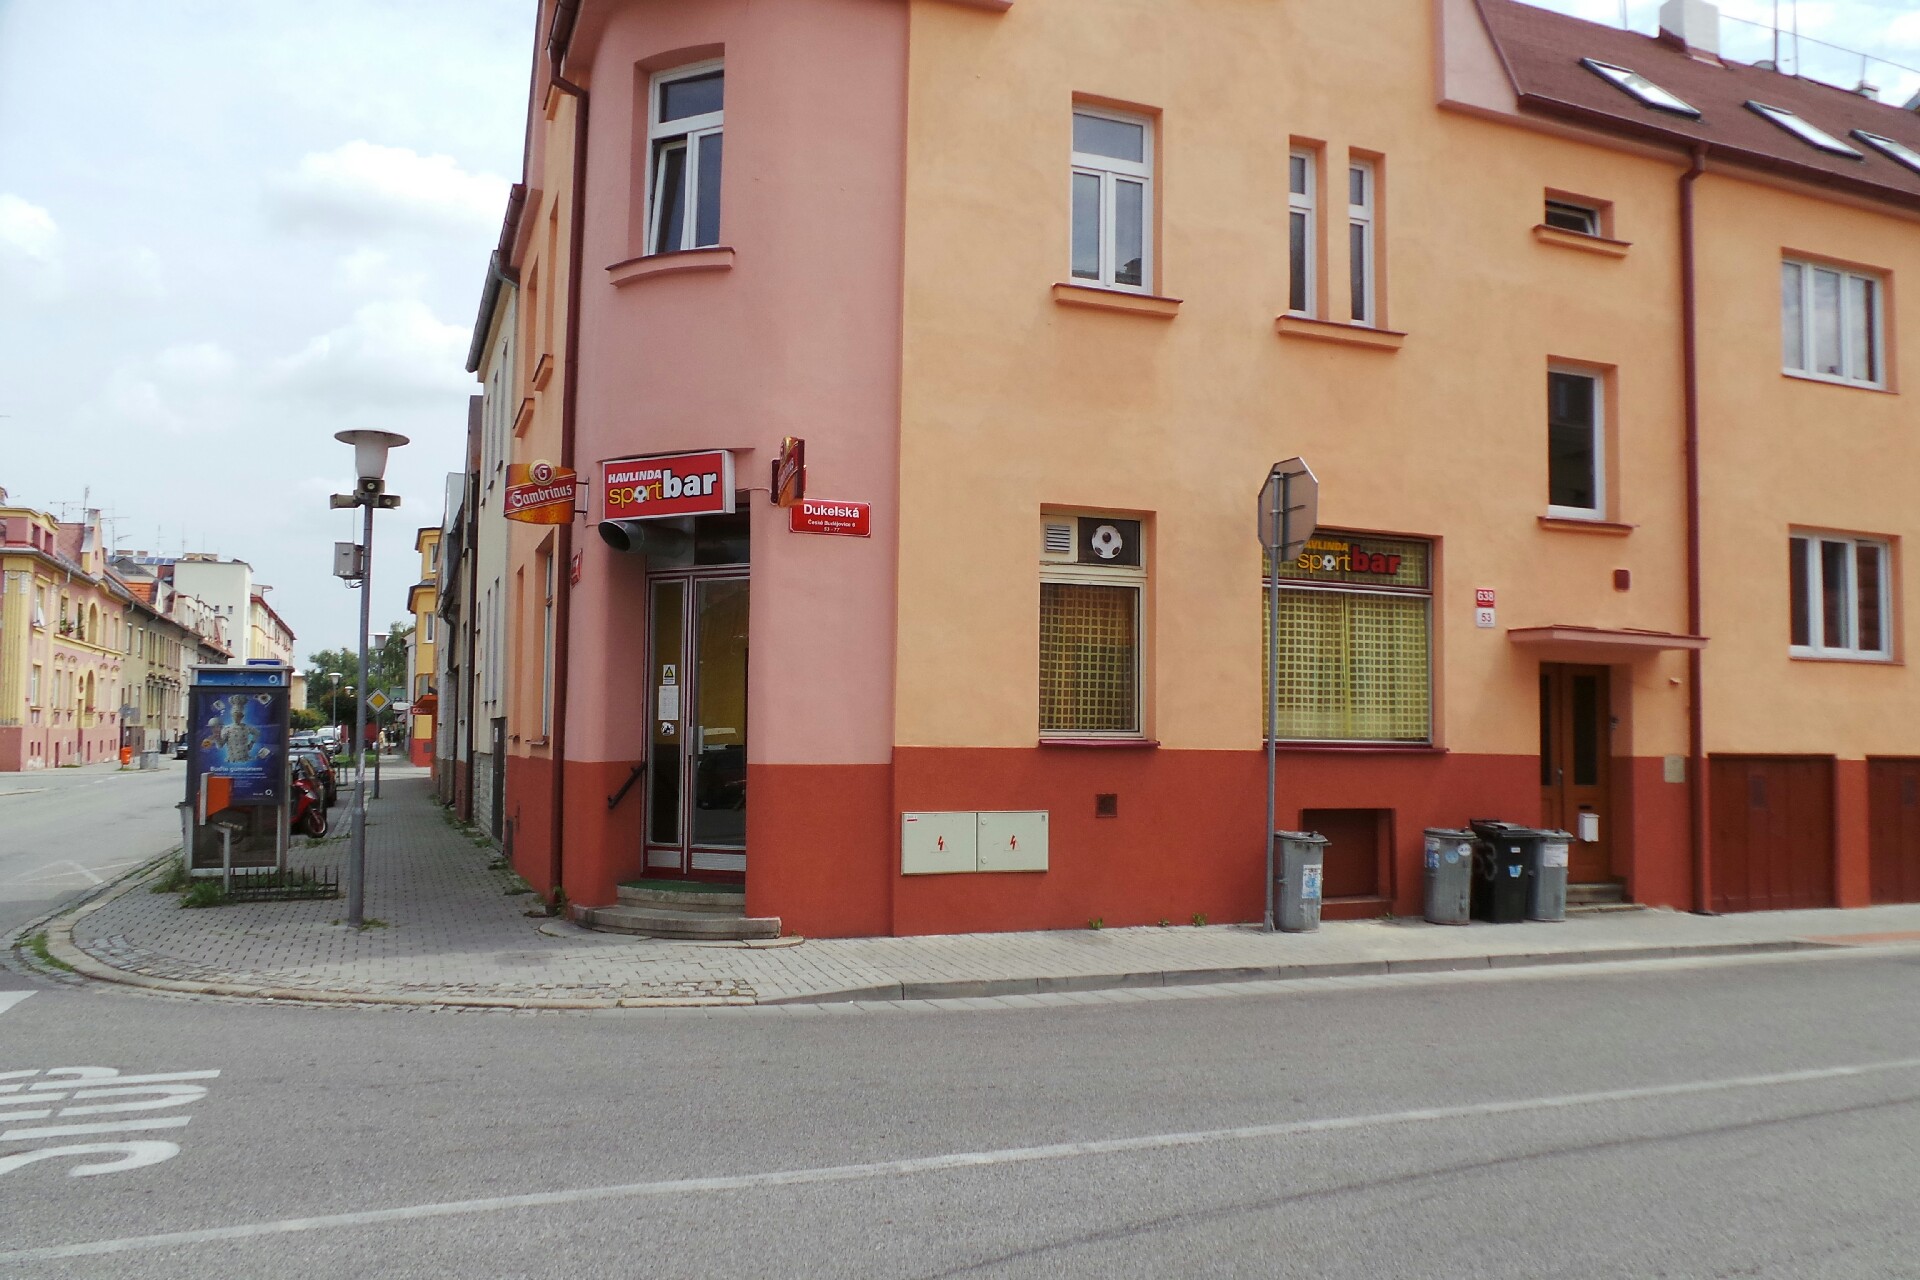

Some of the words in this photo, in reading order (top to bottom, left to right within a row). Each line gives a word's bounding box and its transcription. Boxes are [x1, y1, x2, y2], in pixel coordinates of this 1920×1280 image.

[608, 469, 662, 484] HAVLINDA
[511, 484, 573, 508] Gambrinus
[804, 504, 859, 518] Dukelská
[1304, 540, 1349, 552] AVLINDA
[1481, 612, 1492, 623] 53
